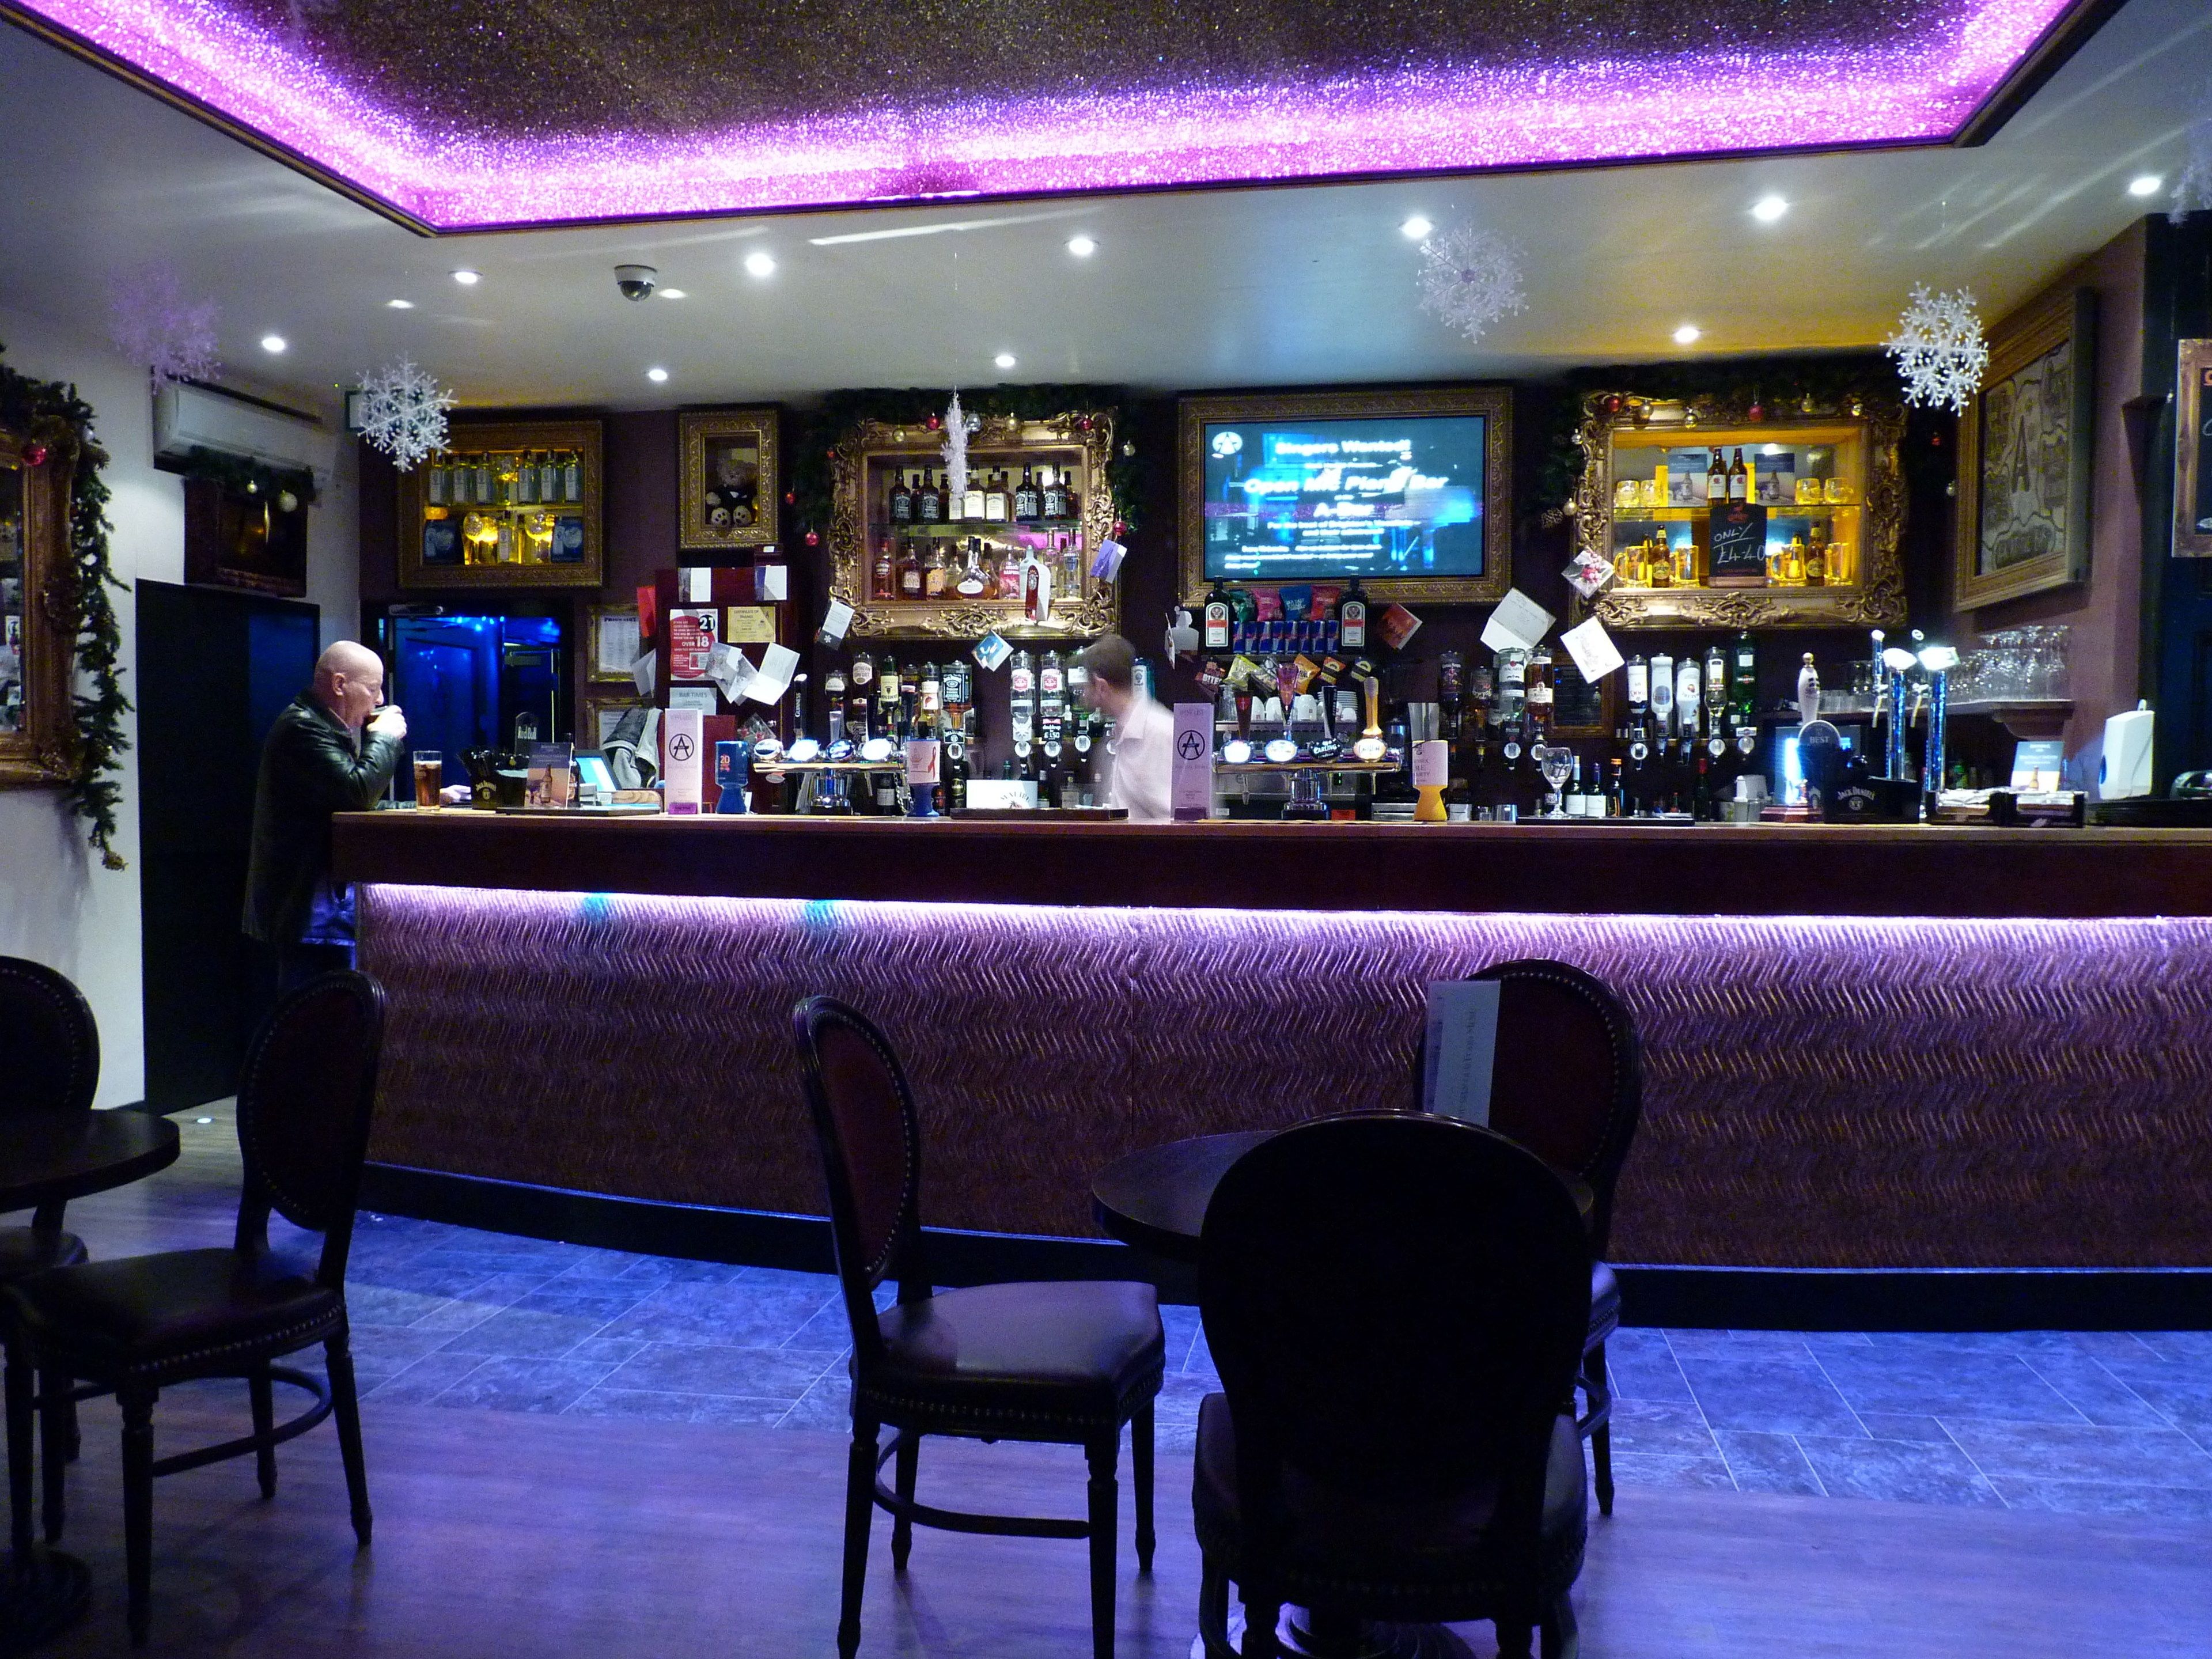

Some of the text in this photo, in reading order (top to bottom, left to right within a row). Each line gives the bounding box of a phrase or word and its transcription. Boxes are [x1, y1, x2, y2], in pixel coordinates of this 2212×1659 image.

[1275, 442, 1339, 456] Singers
[1244, 479, 1300, 495] Open
[1409, 475, 1448, 490] Bar
[1714, 522, 1753, 542] ONLY
[699, 617, 714, 630] 21
[697, 636, 709, 647] 18
[1313, 744, 1337, 754] CARLING
